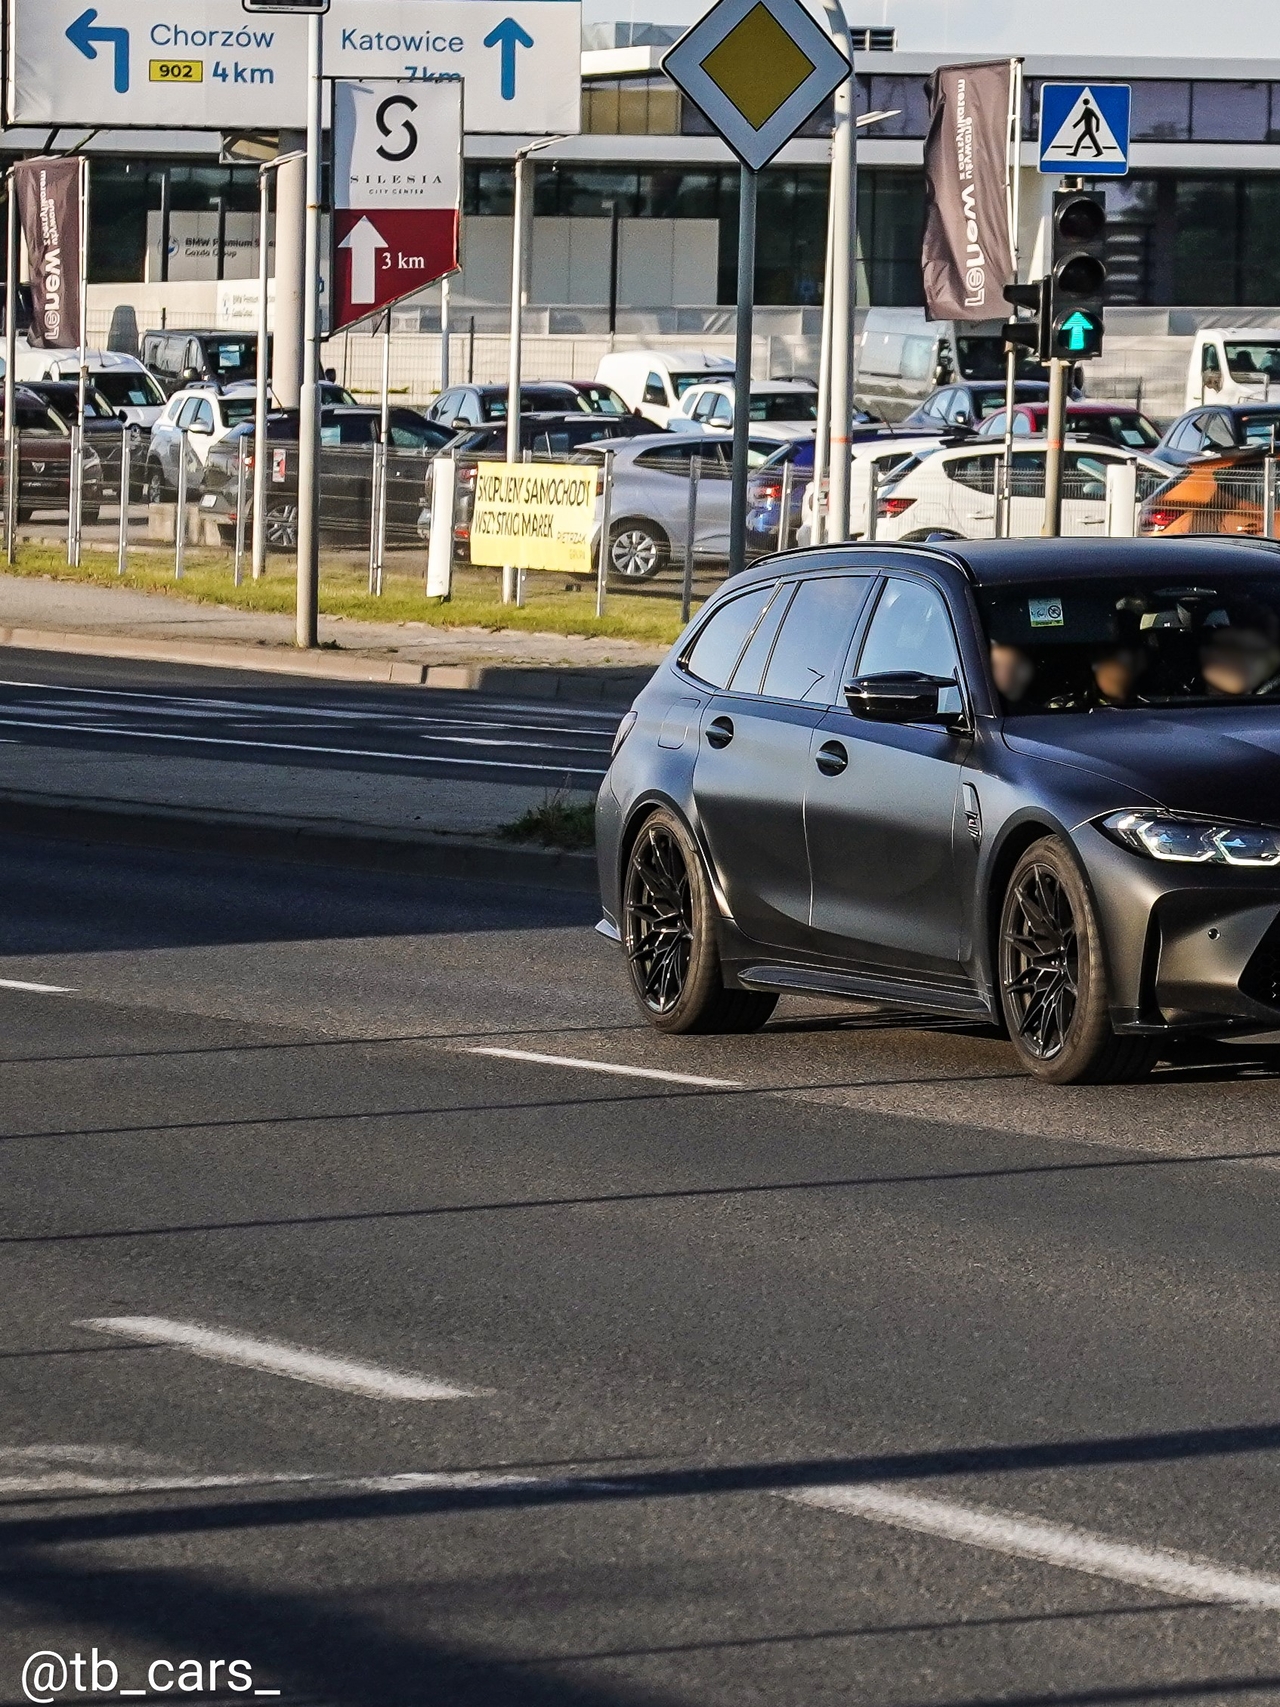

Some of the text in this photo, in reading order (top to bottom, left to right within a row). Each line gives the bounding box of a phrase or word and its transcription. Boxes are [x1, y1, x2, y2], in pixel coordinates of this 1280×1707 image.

[150, 23, 275, 48] Chorzów
[341, 28, 464, 52] Katowice
[159, 65, 193, 78] 902
[350, 174, 443, 184] SILESIA
[185, 238, 210, 247] BMW
[213, 238, 252, 247] Pemium
[381, 252, 425, 270] 3 km
[524, 477, 591, 507] SAMOCHODY
[521, 513, 554, 538] MAREK
